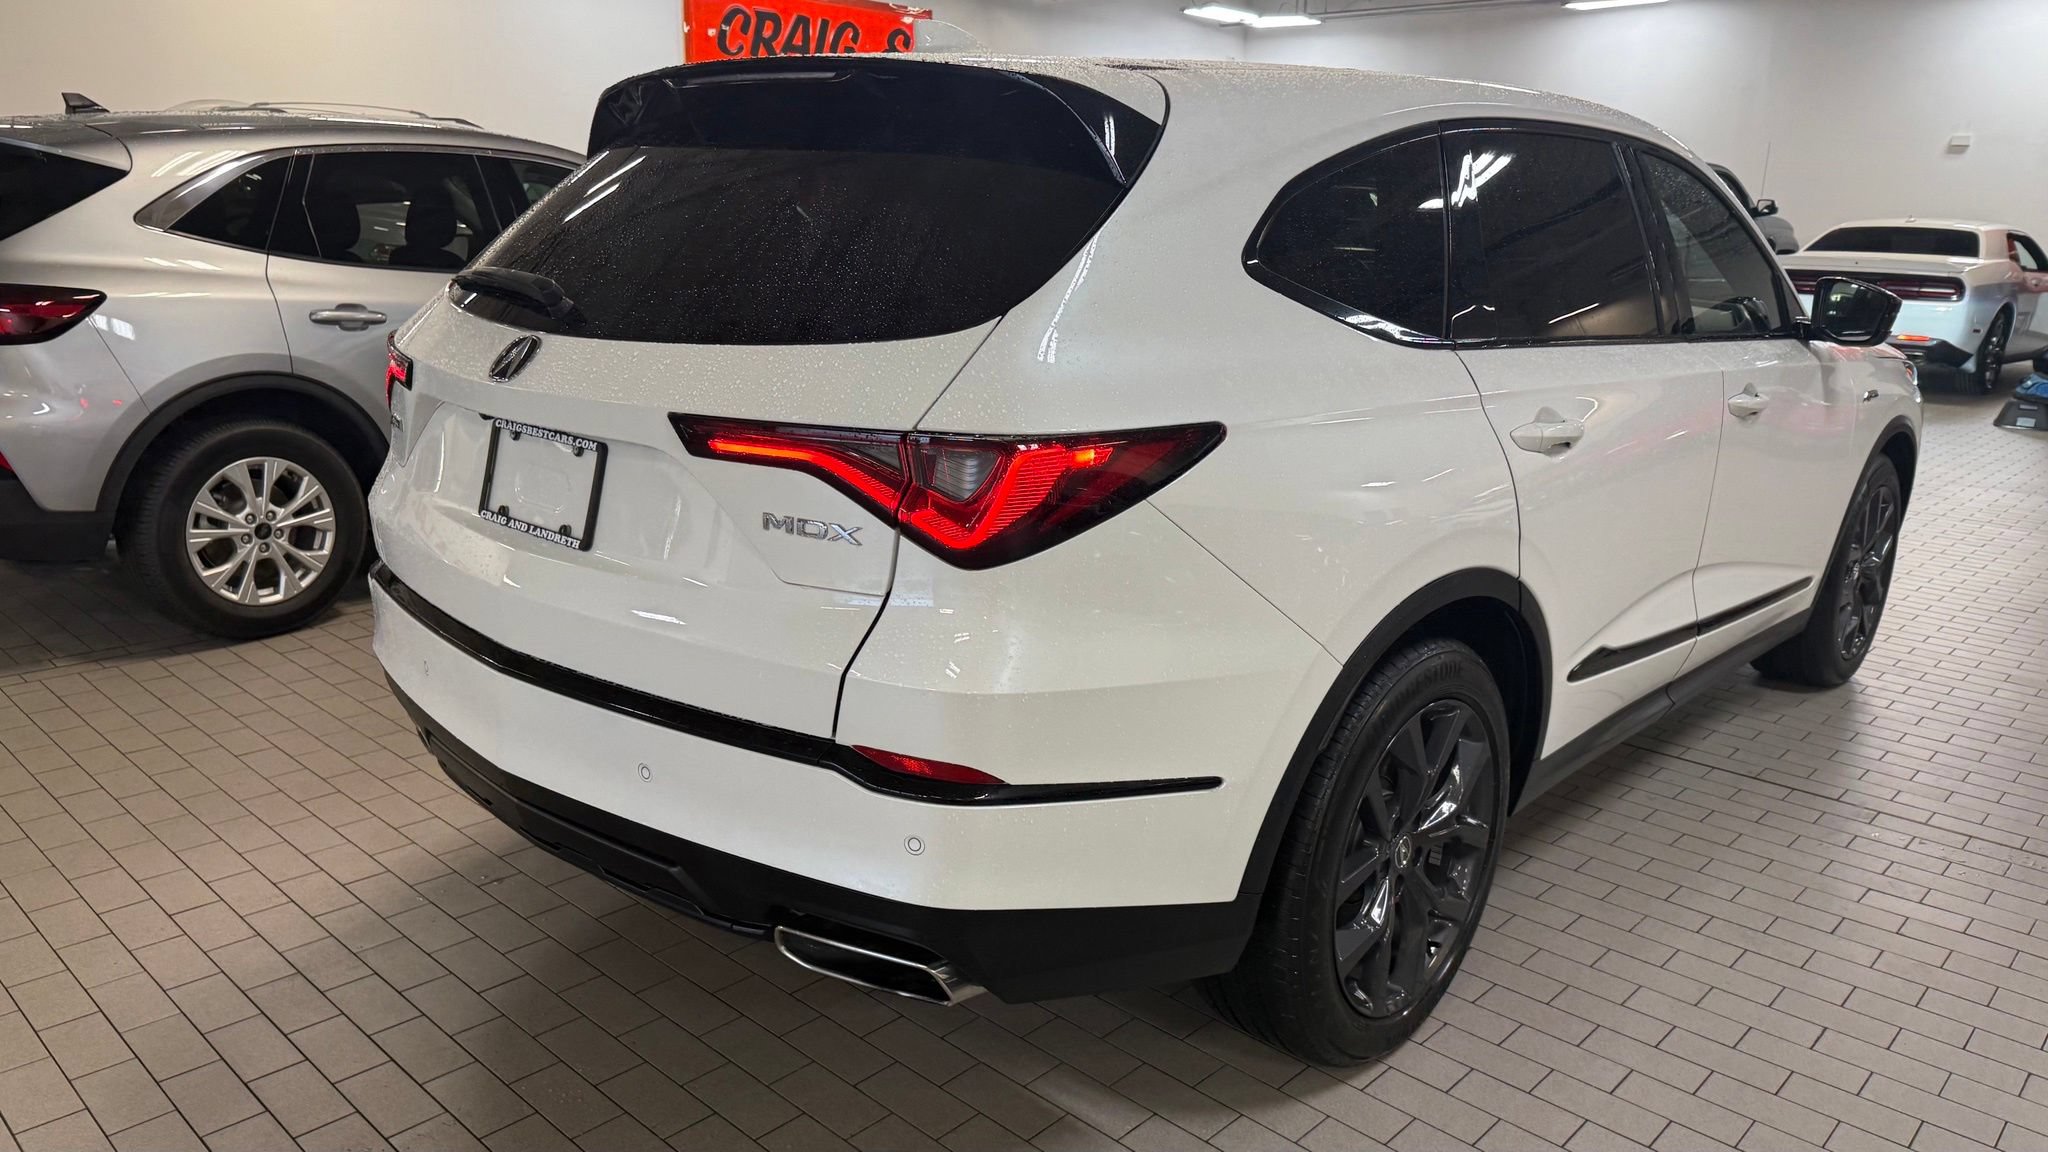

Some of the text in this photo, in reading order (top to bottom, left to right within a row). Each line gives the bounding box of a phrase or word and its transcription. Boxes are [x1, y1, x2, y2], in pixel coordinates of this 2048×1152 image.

[717, 5, 860, 57] CRAIG
[495, 419, 598, 451] CRAIGSBESTCARS.COM
[480, 509, 581, 550] CRAIG AND LANDRETH
[762, 511, 863, 546] MDX
